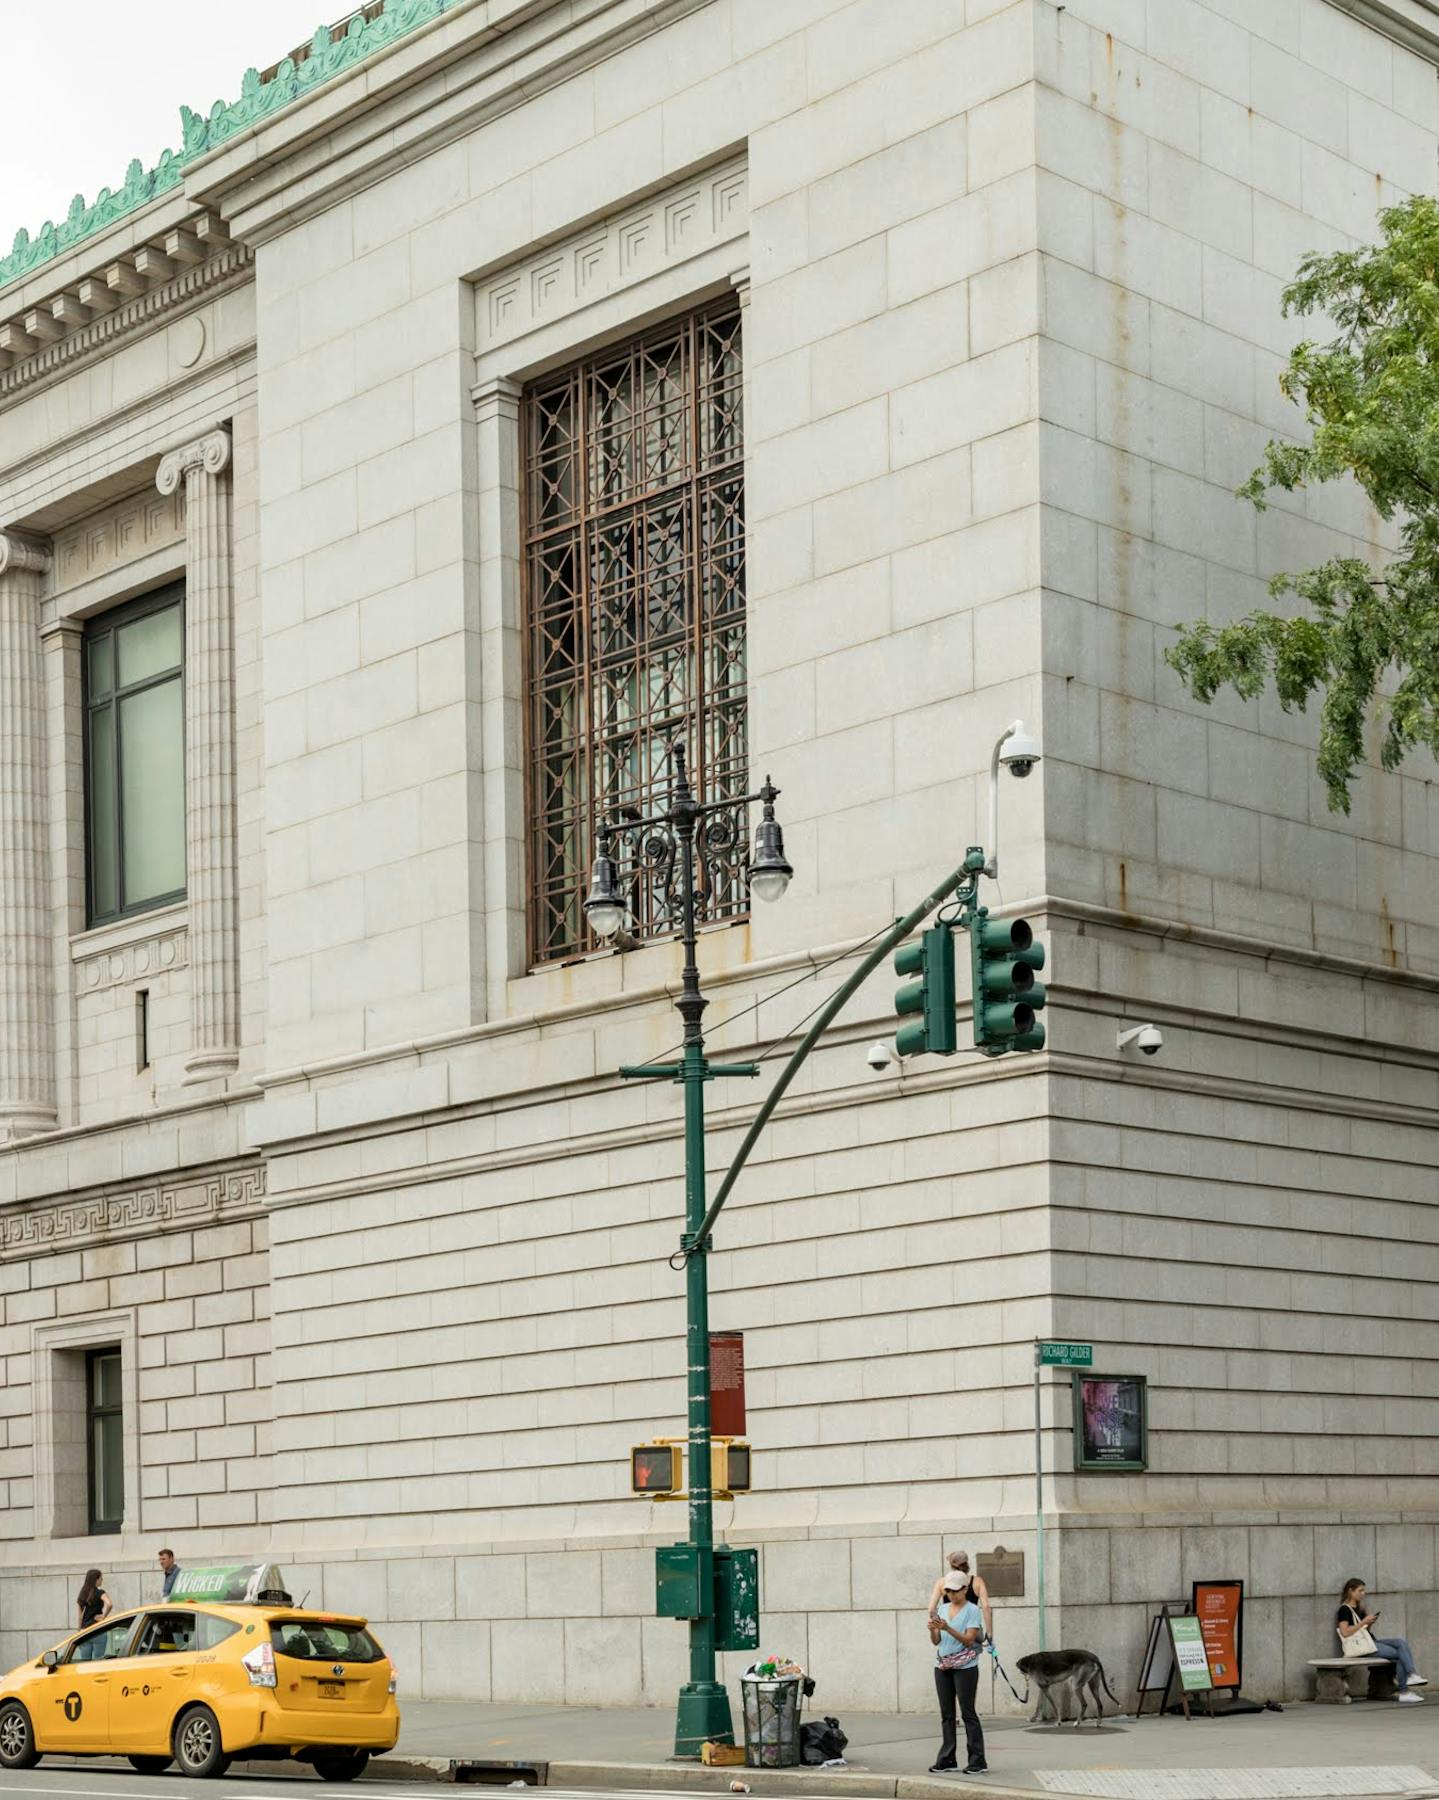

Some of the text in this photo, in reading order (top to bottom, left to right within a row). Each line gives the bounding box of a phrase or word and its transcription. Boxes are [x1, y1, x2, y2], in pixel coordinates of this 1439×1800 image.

[1042, 1345, 1091, 1359] RICHARD GILDER
[68, 1697, 79, 1718] T
